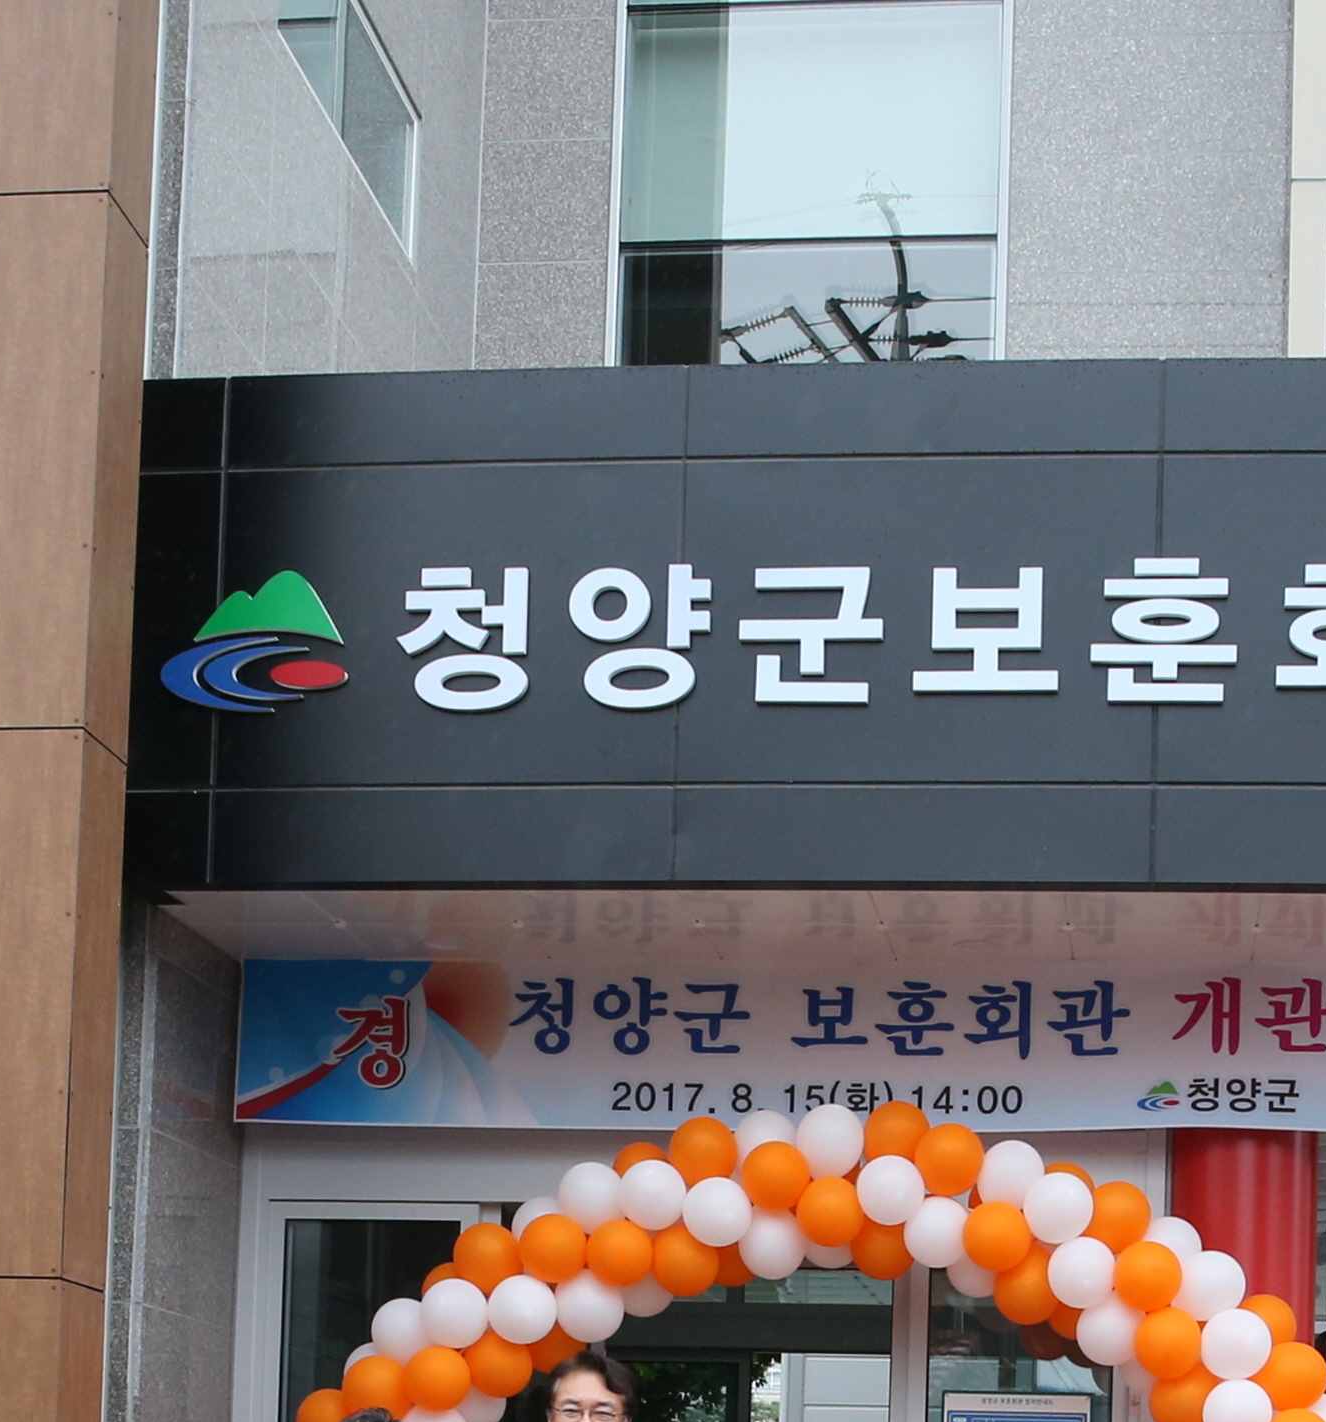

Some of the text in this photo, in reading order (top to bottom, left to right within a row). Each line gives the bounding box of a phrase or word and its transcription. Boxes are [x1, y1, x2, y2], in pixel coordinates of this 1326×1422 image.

[332, 995, 409, 1089] 경
[509, 977, 751, 1055] 청양군
[790, 981, 1130, 1060] 보훈회관
[612, 1081, 716, 1114] 2017.
[731, 1082, 764, 1114] 8
[911, 1085, 1023, 1115] 14:00
[1186, 1077, 1300, 1113] 청양군
